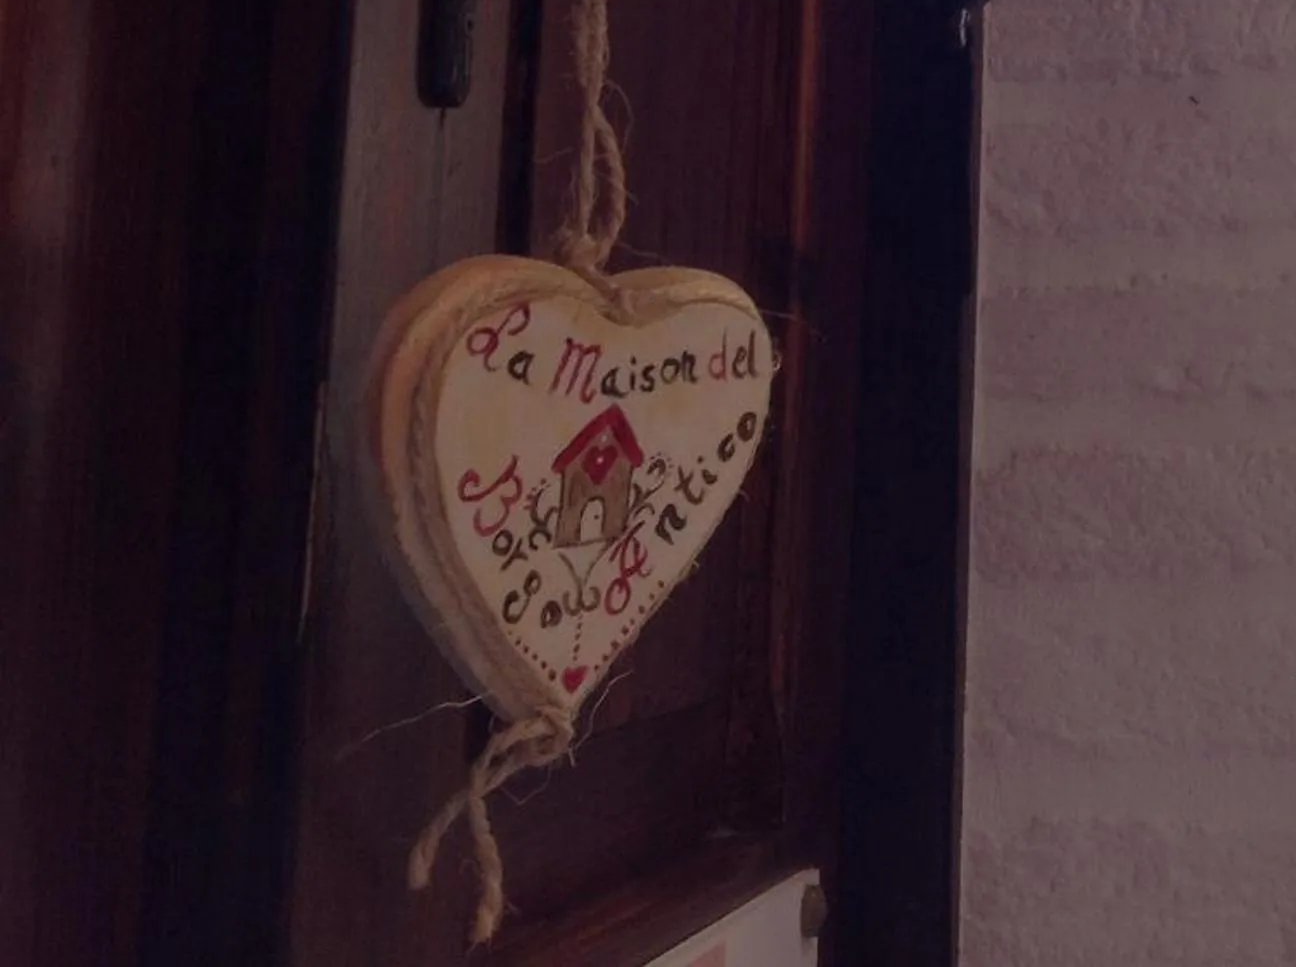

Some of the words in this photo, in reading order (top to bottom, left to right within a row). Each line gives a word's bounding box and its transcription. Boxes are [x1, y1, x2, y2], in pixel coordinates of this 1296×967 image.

[466, 301, 534, 385] La
[550, 336, 699, 404] Maison
[708, 327, 758, 380] del
[604, 411, 757, 615] Antico
